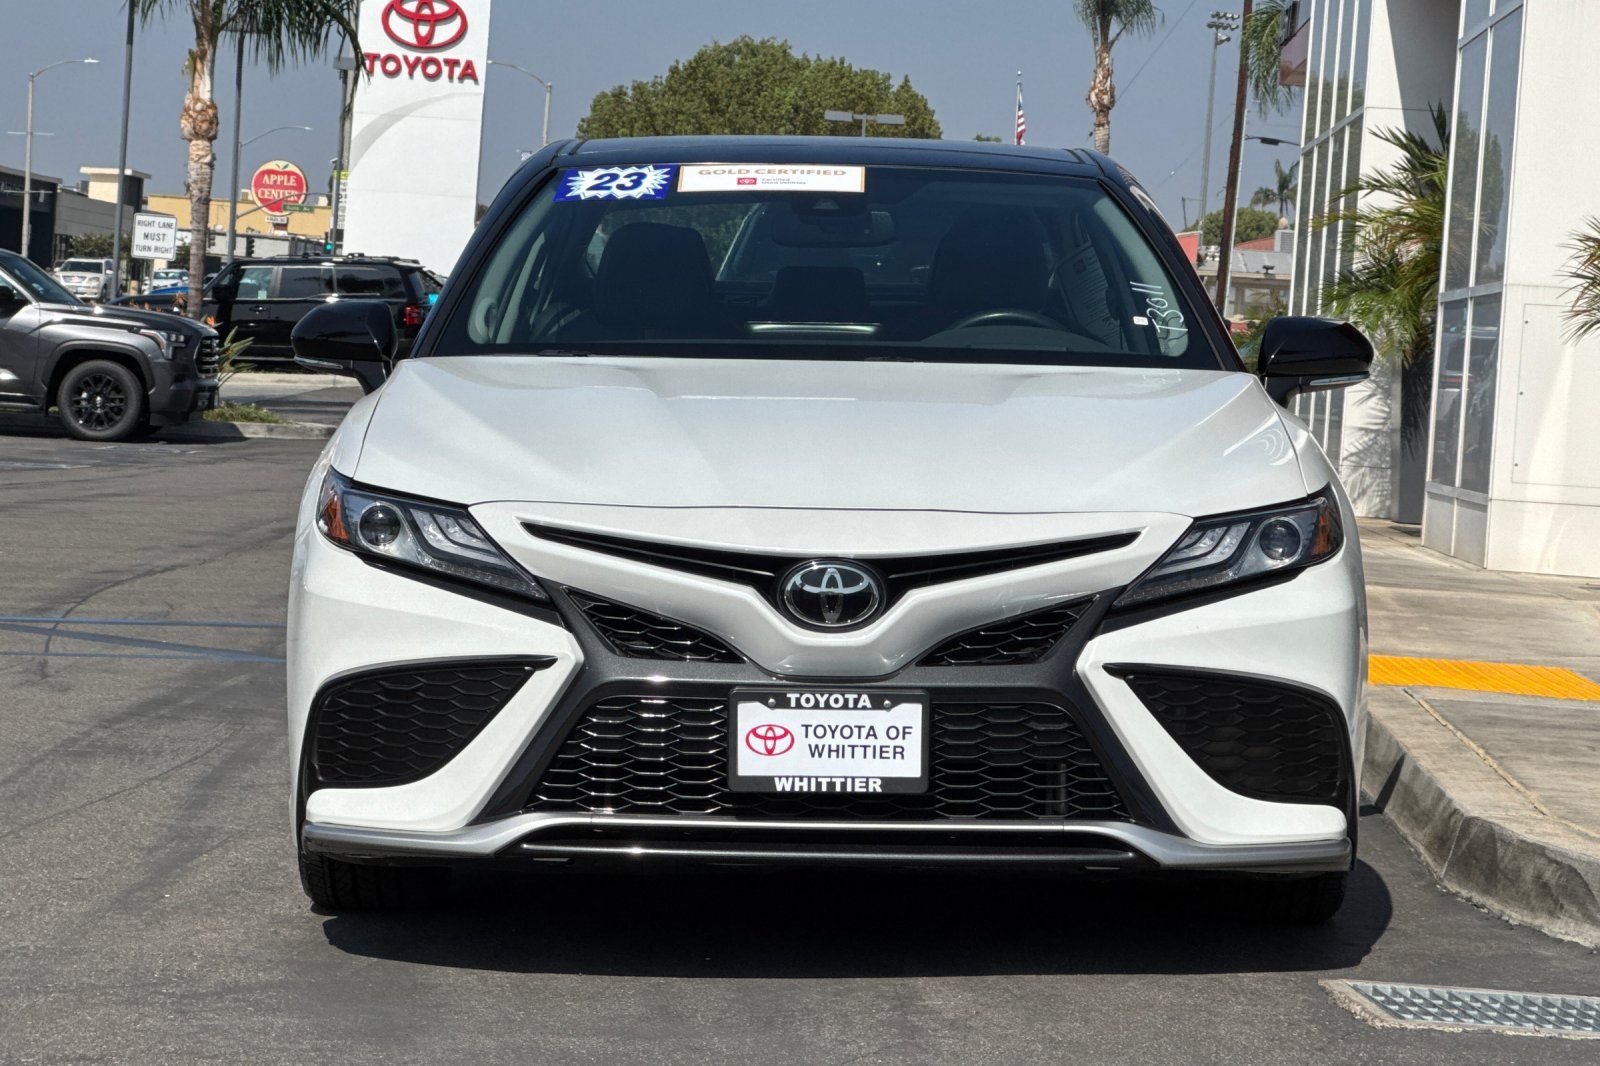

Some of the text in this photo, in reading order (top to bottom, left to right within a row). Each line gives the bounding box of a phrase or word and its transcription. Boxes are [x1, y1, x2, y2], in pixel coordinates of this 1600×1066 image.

[363, 52, 478, 84] TOYOTA
[262, 174, 297, 186] APPLE
[585, 172, 648, 191] 23
[257, 188, 298, 201] CENTER
[137, 219, 174, 229] RIGHT LANE
[143, 232, 167, 241] MUST
[135, 244, 173, 254] TURN RIGHT
[786, 693, 872, 709] TOYOTA
[801, 724, 913, 741] TOYOTA OF
[808, 743, 905, 760] WHITTIER
[774, 776, 882, 793] WHITTIER
